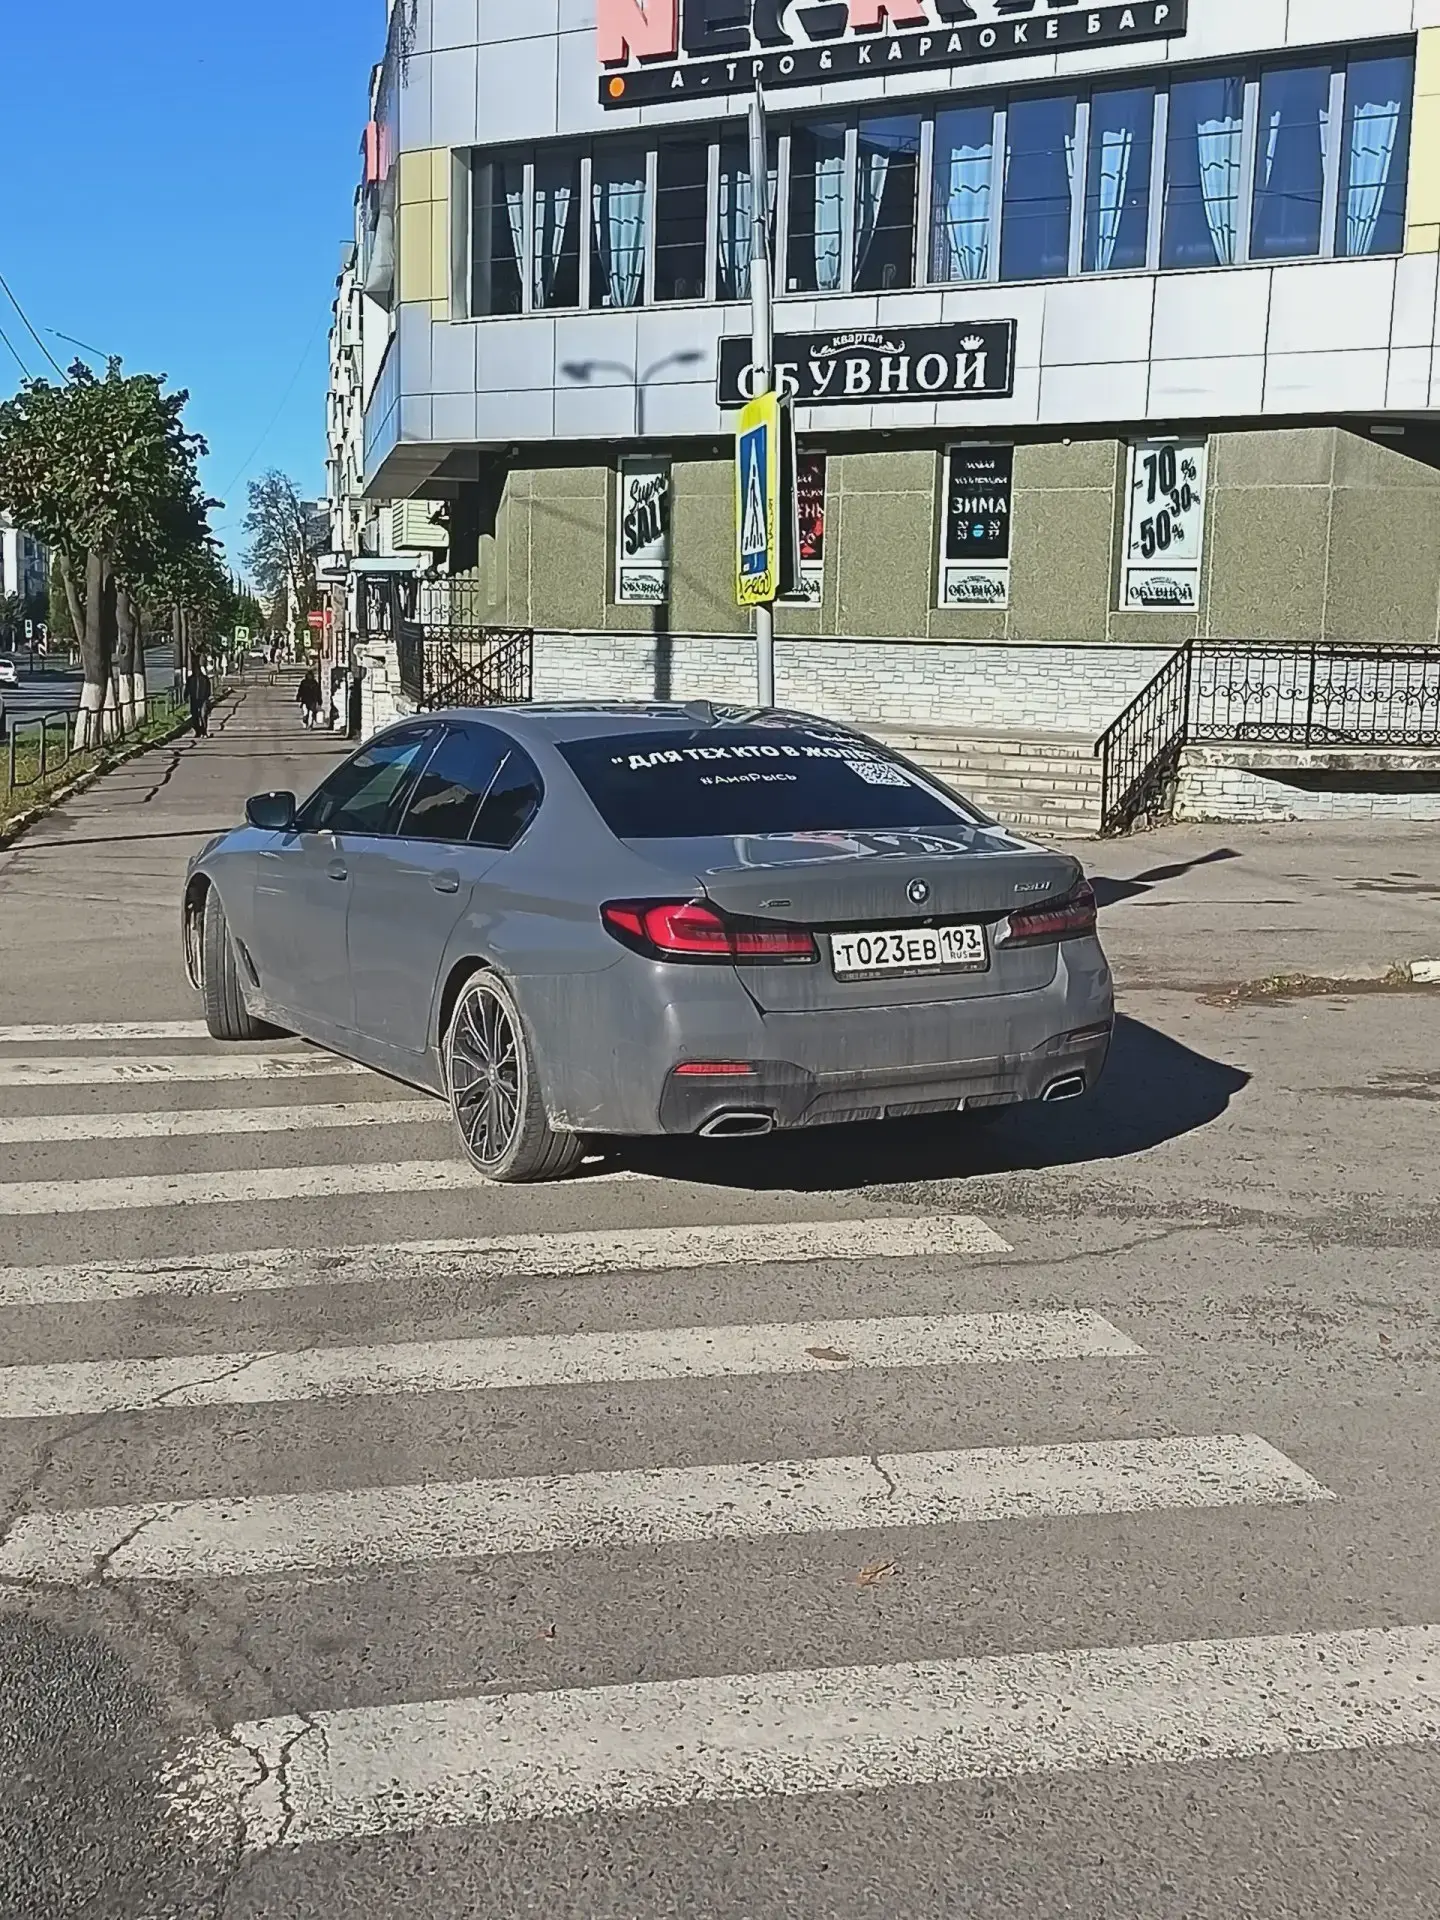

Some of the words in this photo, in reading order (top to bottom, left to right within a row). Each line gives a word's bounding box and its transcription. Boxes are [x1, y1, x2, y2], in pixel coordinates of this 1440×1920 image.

[1087, 4, 1170, 34] БАР
[832, 333, 884, 347] квартал
[952, 496, 1008, 515] ЗИМА
[611, 749, 684, 770] "ДЛЯ
[682, 746, 733, 760] ТЕХ
[729, 745, 780, 758] КТО
[780, 746, 800, 758] В
[840, 935, 938, 966] Т023ЕВ
[942, 929, 976, 951] 193
[950, 950, 968, 959] RUS
